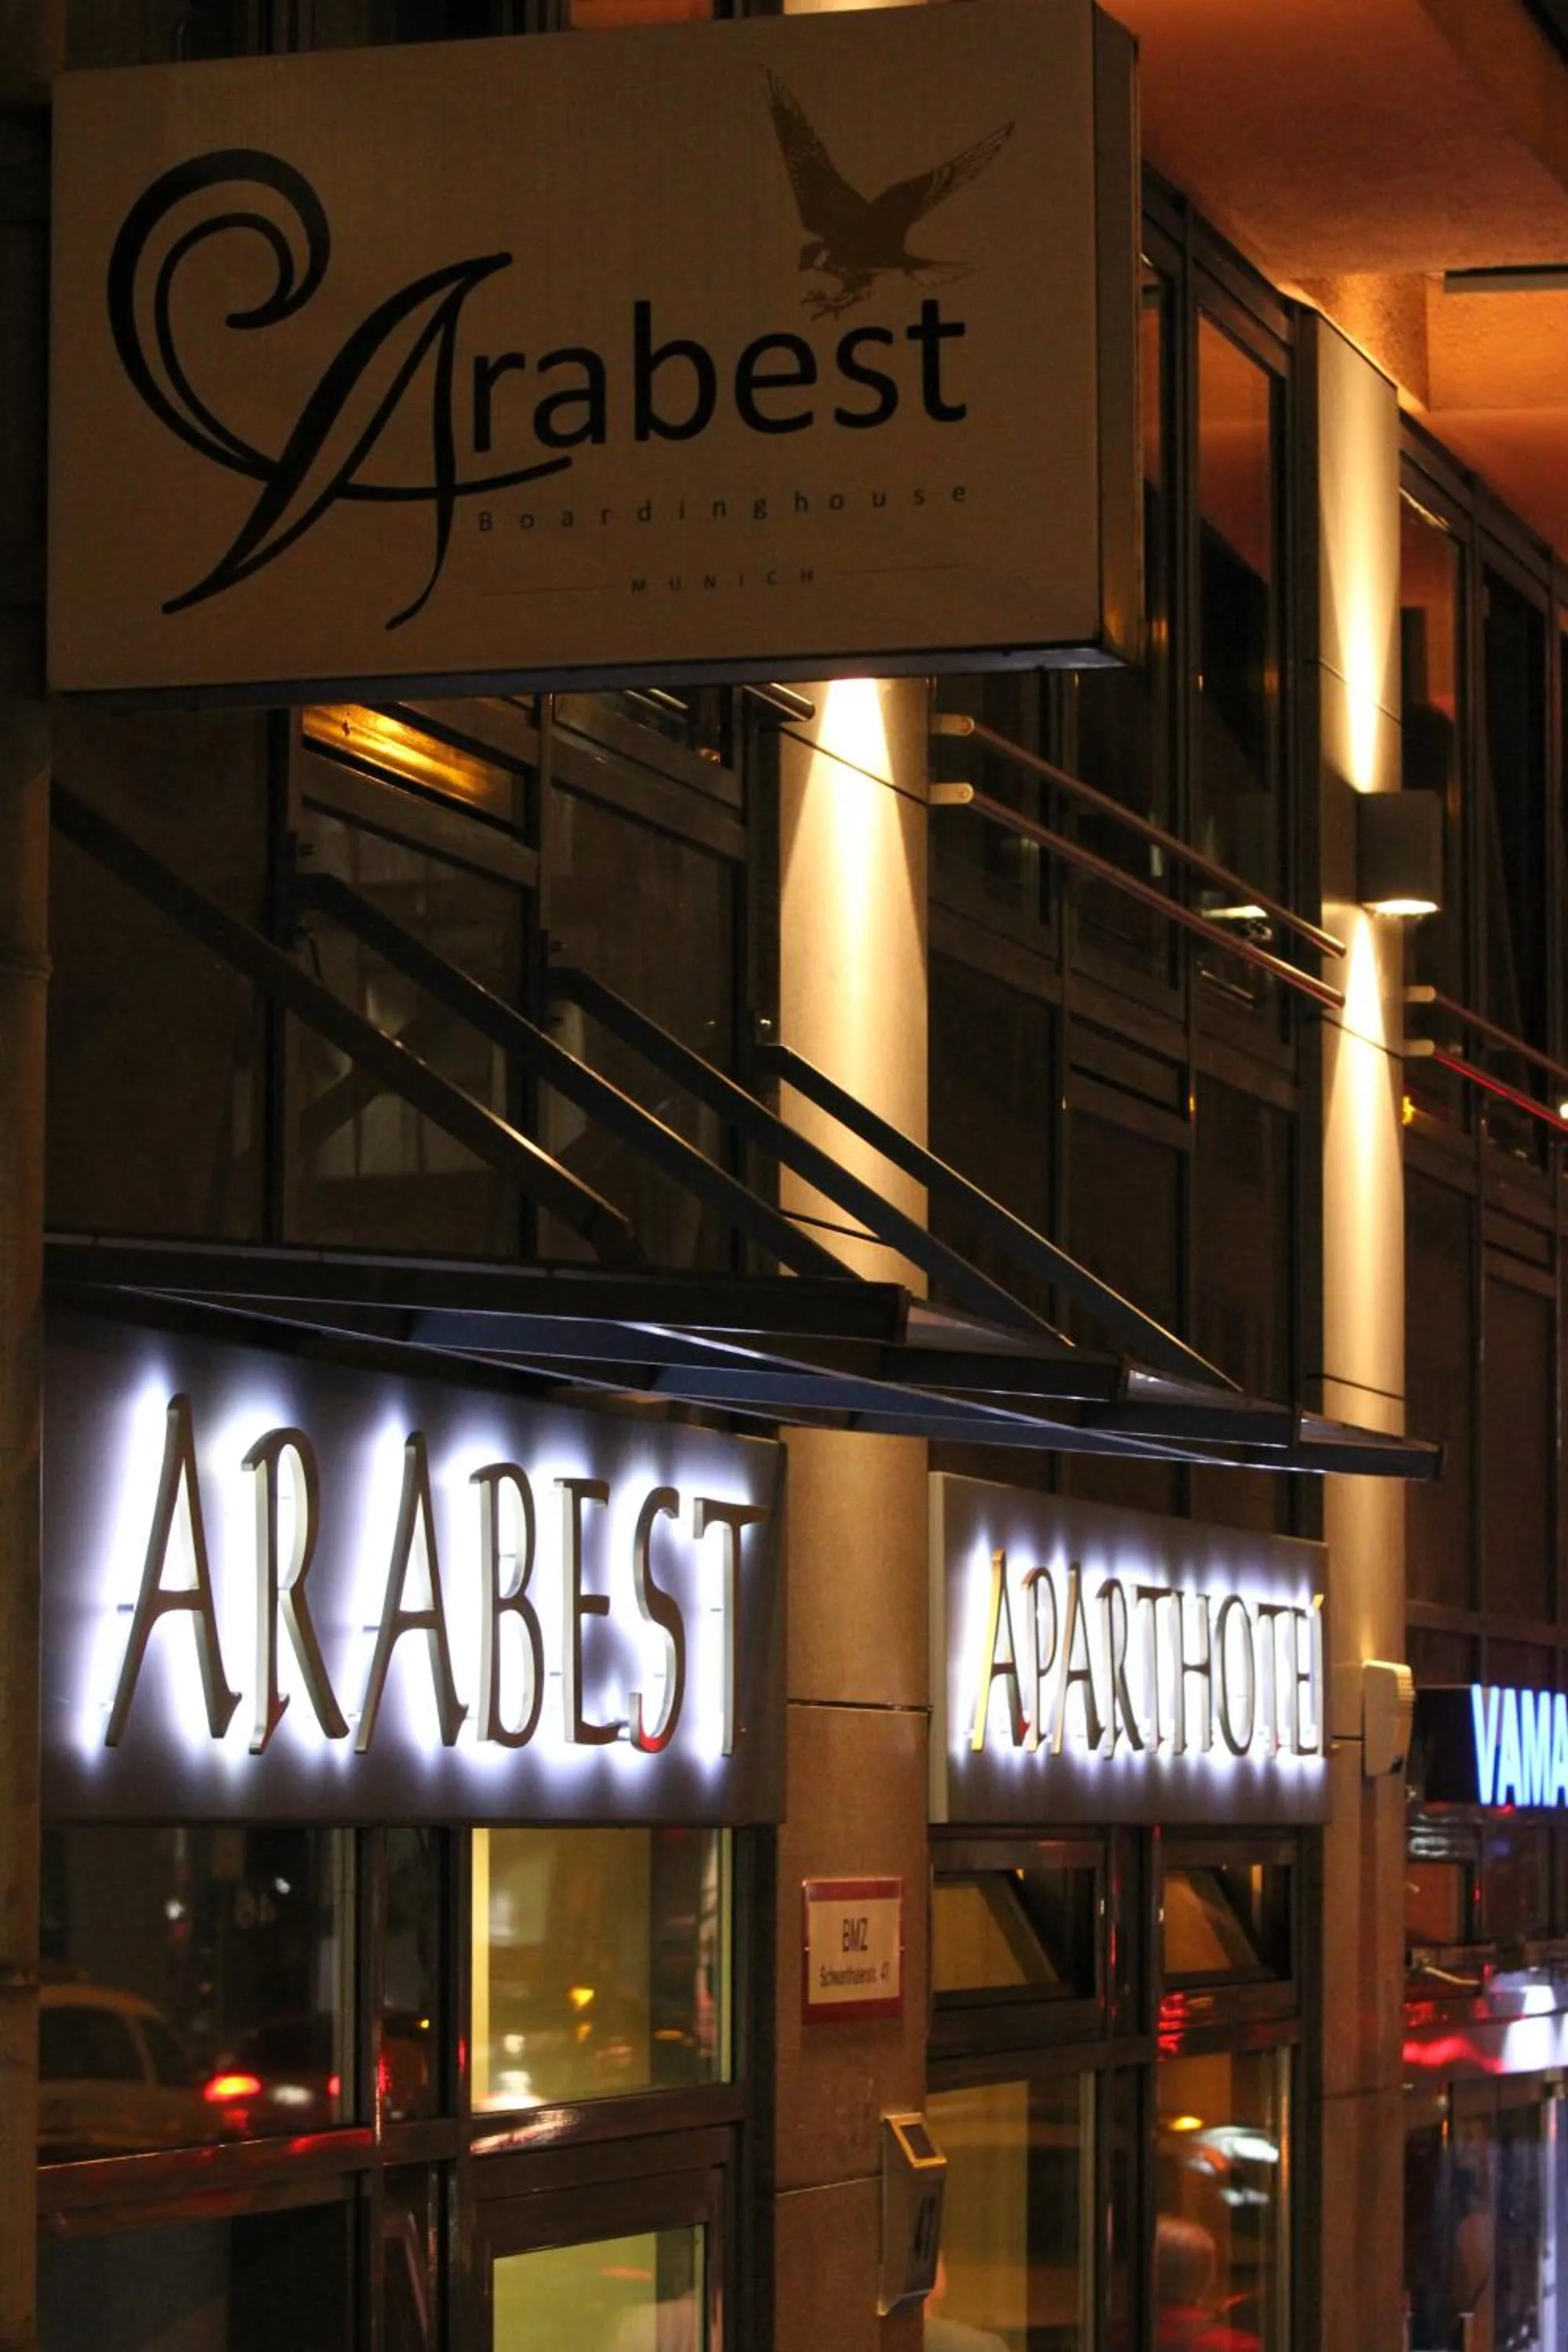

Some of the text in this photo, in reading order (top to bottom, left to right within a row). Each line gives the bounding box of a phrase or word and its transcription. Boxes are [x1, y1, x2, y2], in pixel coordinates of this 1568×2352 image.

[107, 148, 968, 630] Arabest
[477, 483, 967, 533] Boardinghouse
[630, 566, 815, 594] MUNICH
[103, 1392, 769, 1758] ARABEST
